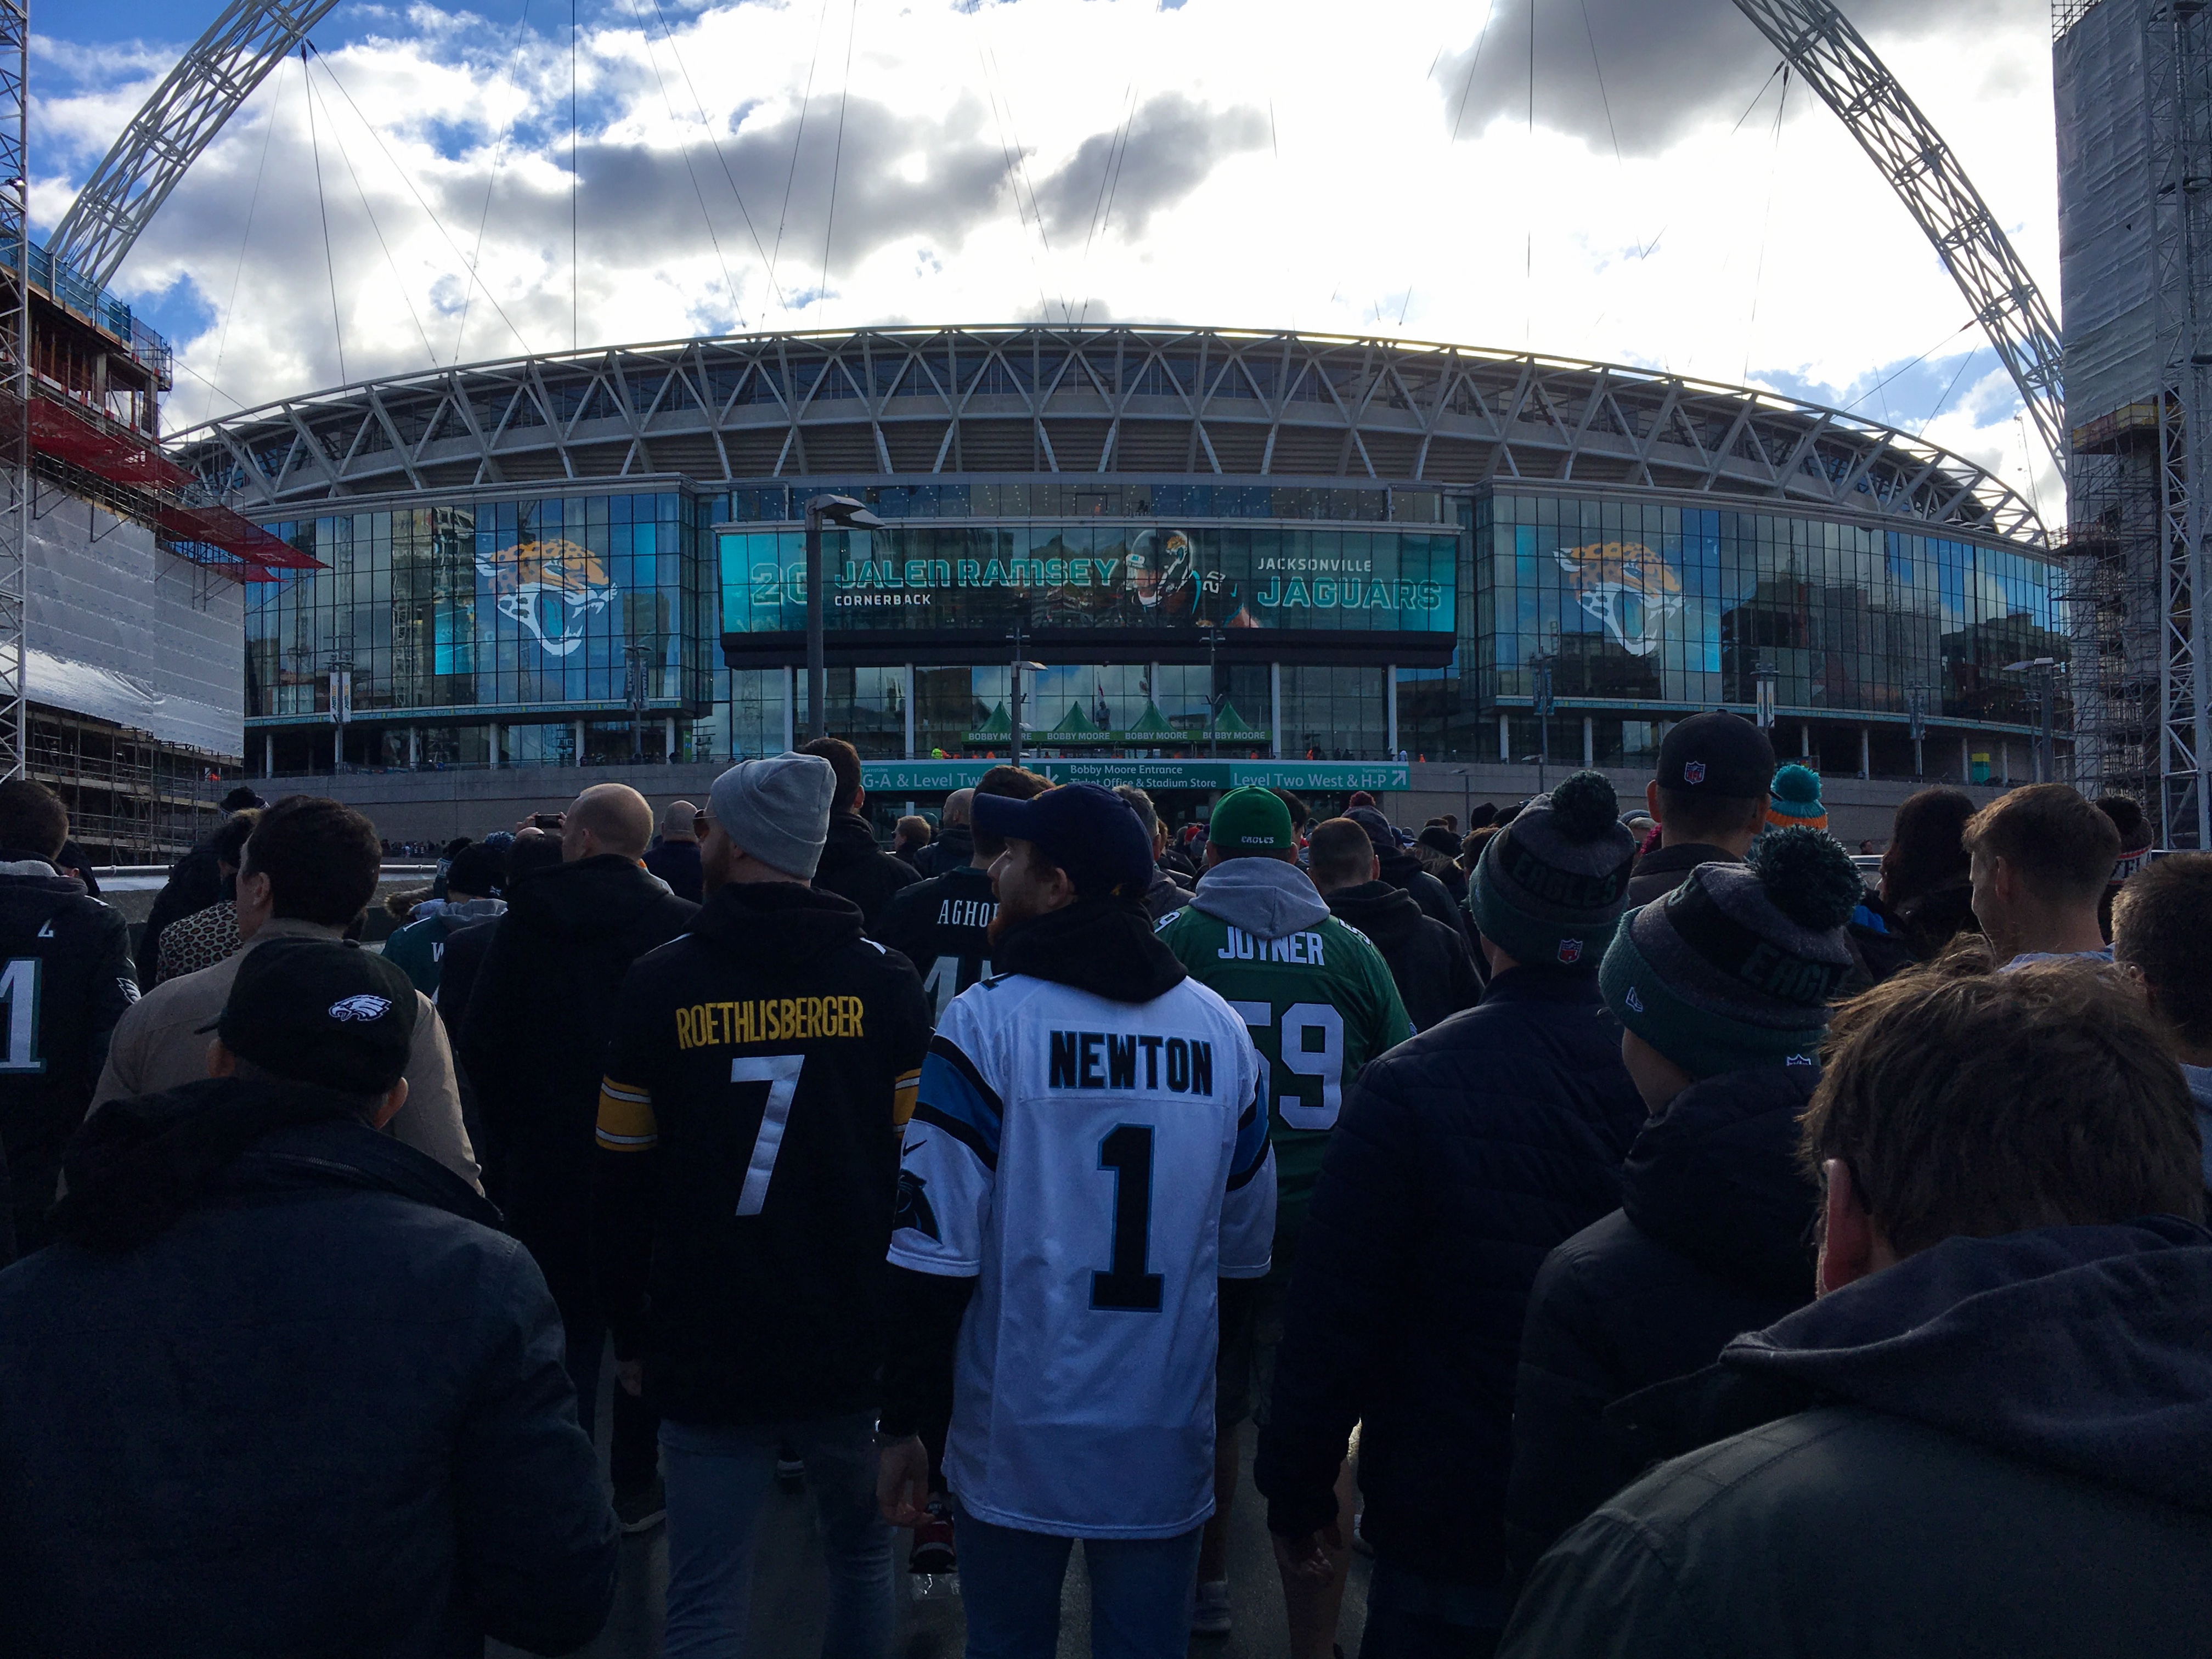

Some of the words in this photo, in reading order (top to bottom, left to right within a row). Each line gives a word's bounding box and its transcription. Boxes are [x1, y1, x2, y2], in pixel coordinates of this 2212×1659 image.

[834, 559, 951, 589] JALEN
[957, 557, 1119, 587] RAMSEY
[1257, 558, 1372, 572] JACKSONVILLE
[834, 595, 931, 606] CORNERBACK
[1257, 576, 1442, 610] JAGUARS
[862, 774, 891, 788] G-A
[896, 774, 909, 787] &
[914, 773, 952, 787] Level
[1070, 765, 1102, 776] Bobby
[1104, 765, 1136, 774] Moore
[1139, 765, 1183, 774] Entrance
[1136, 778, 1144, 787] &
[1146, 778, 1188, 787] Stadium
[1190, 778, 1217, 787] Store
[1234, 772, 1270, 786] Level
[1274, 774, 1304, 786] Two
[1308, 774, 1343, 787] West
[1347, 774, 1358, 787] &
[1362, 774, 1386, 787] H-P
[1241, 836, 1274, 844] EAGLES
[1218, 926, 1325, 966] JOYNER
[675, 996, 864, 1050] ROETHLISBERGER
[1048, 1030, 1213, 1097] NEWTON
[1228, 1000, 1345, 1130] 9
[730, 1054, 805, 1216] 7
[1088, 1122, 1165, 1313] 1
